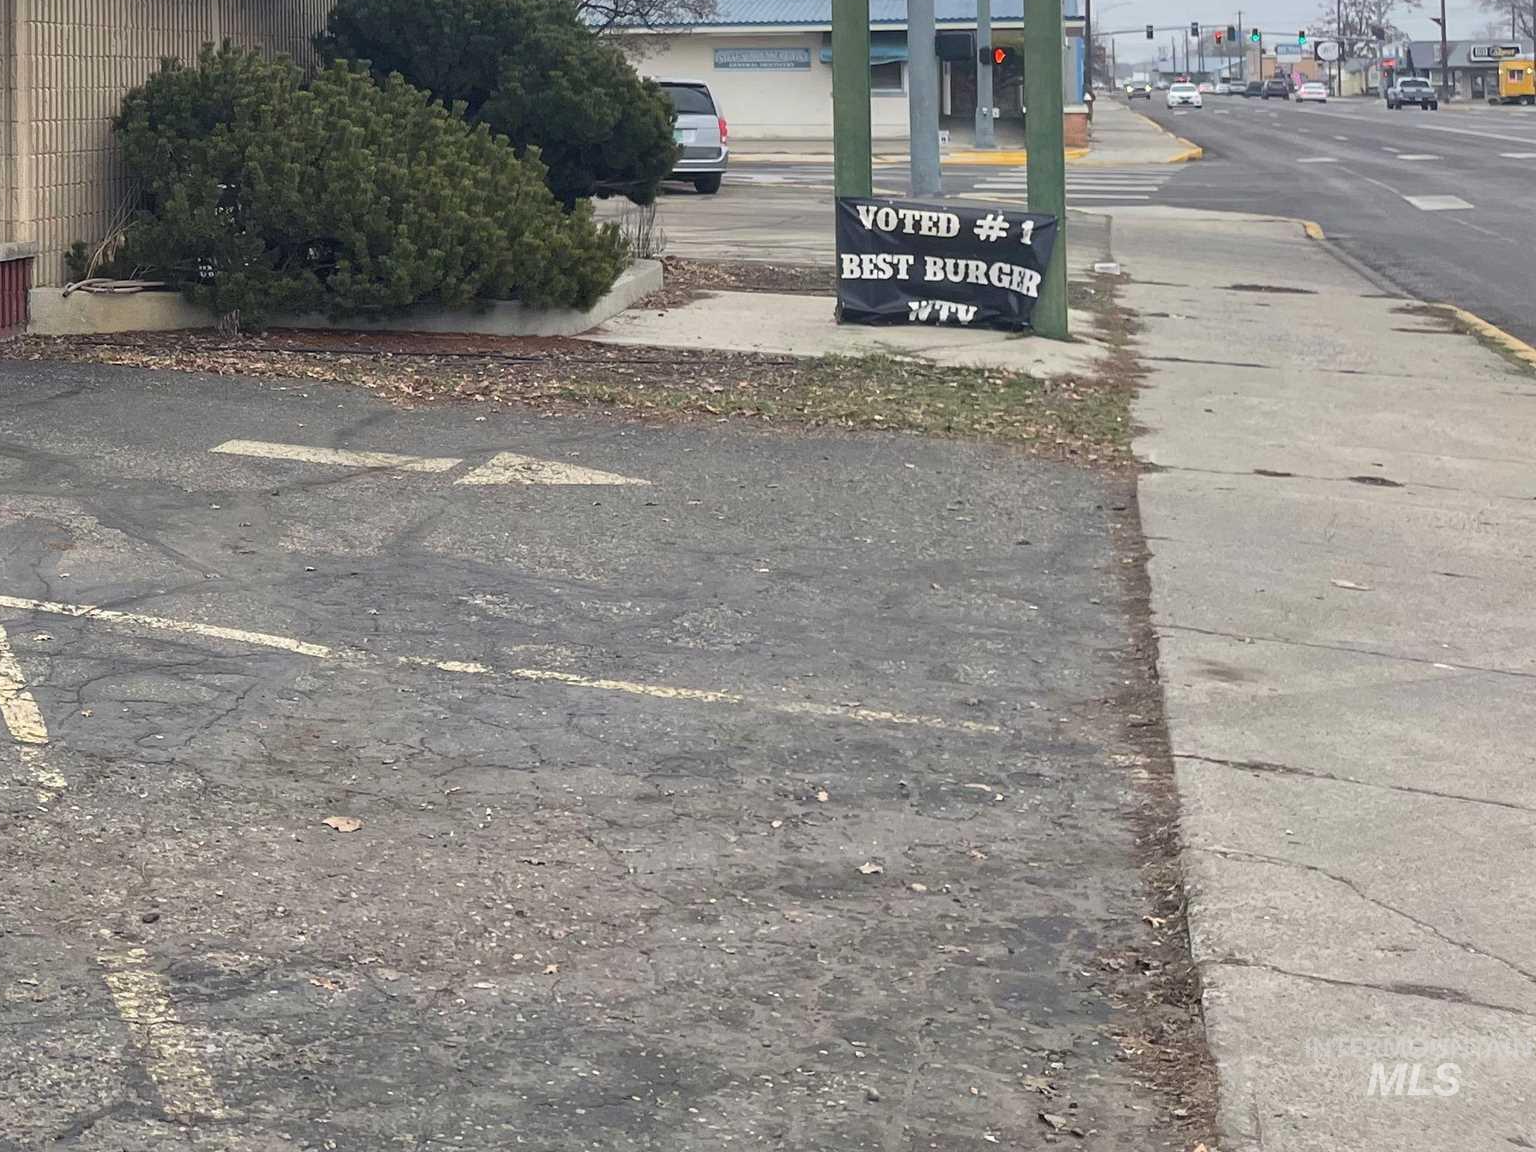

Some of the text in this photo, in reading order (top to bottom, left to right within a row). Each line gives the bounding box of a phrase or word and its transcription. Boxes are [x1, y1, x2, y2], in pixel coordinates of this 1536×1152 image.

[855, 204, 961, 238] VOTED
[840, 253, 1043, 299] BEST BURGER
